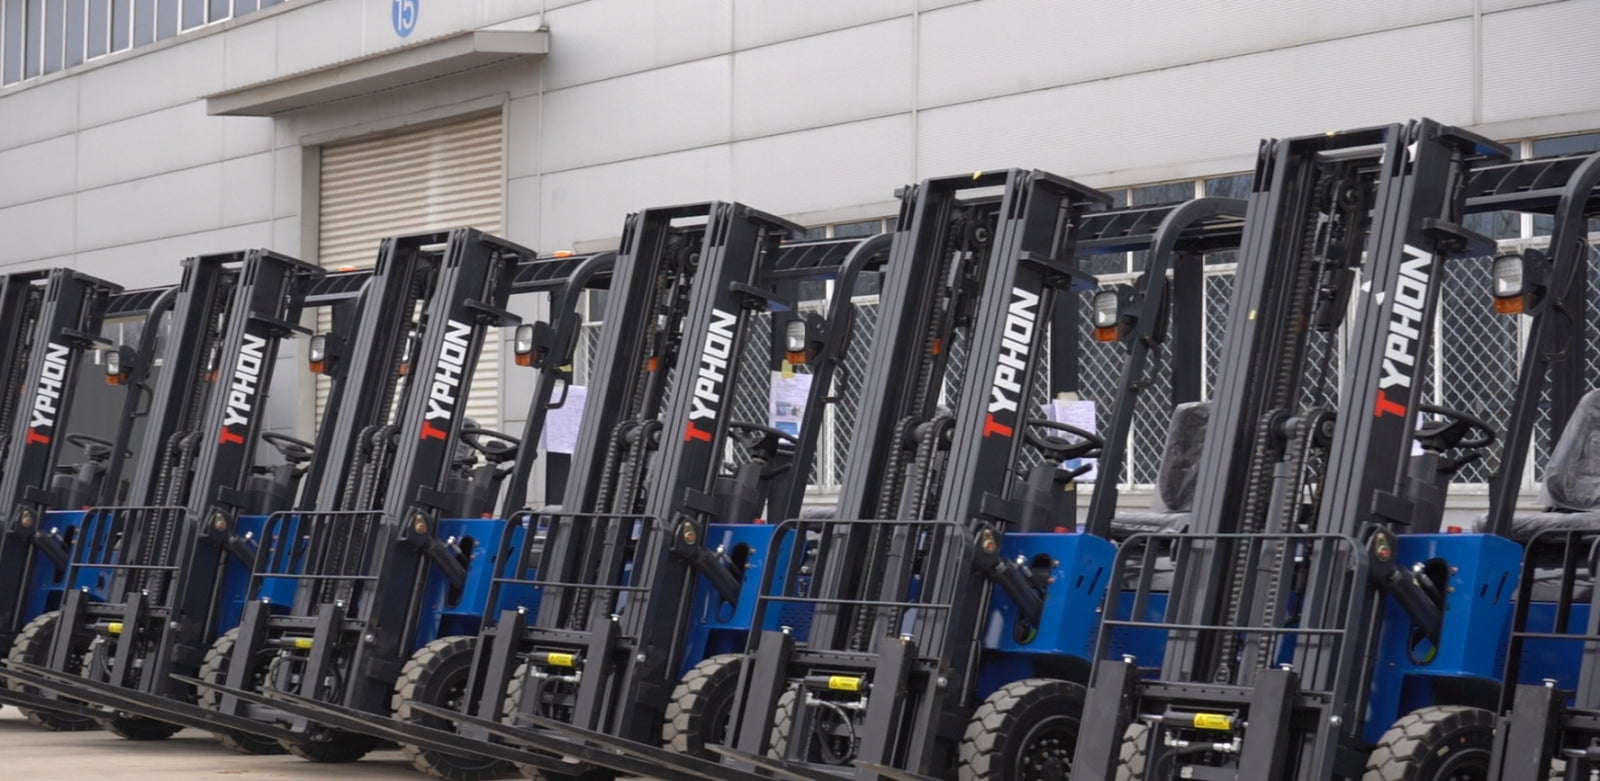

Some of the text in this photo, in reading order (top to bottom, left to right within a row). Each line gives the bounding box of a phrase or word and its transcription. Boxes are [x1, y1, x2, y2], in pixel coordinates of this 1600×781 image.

[395, 0, 415, 31] 15
[220, 333, 266, 444] TYPHON
[421, 319, 472, 440] TYPHON
[685, 309, 738, 442] TYPHON
[984, 287, 1040, 438] TYPHON
[1374, 243, 1432, 417] TYPHON
[27, 342, 70, 444] TYPHON
